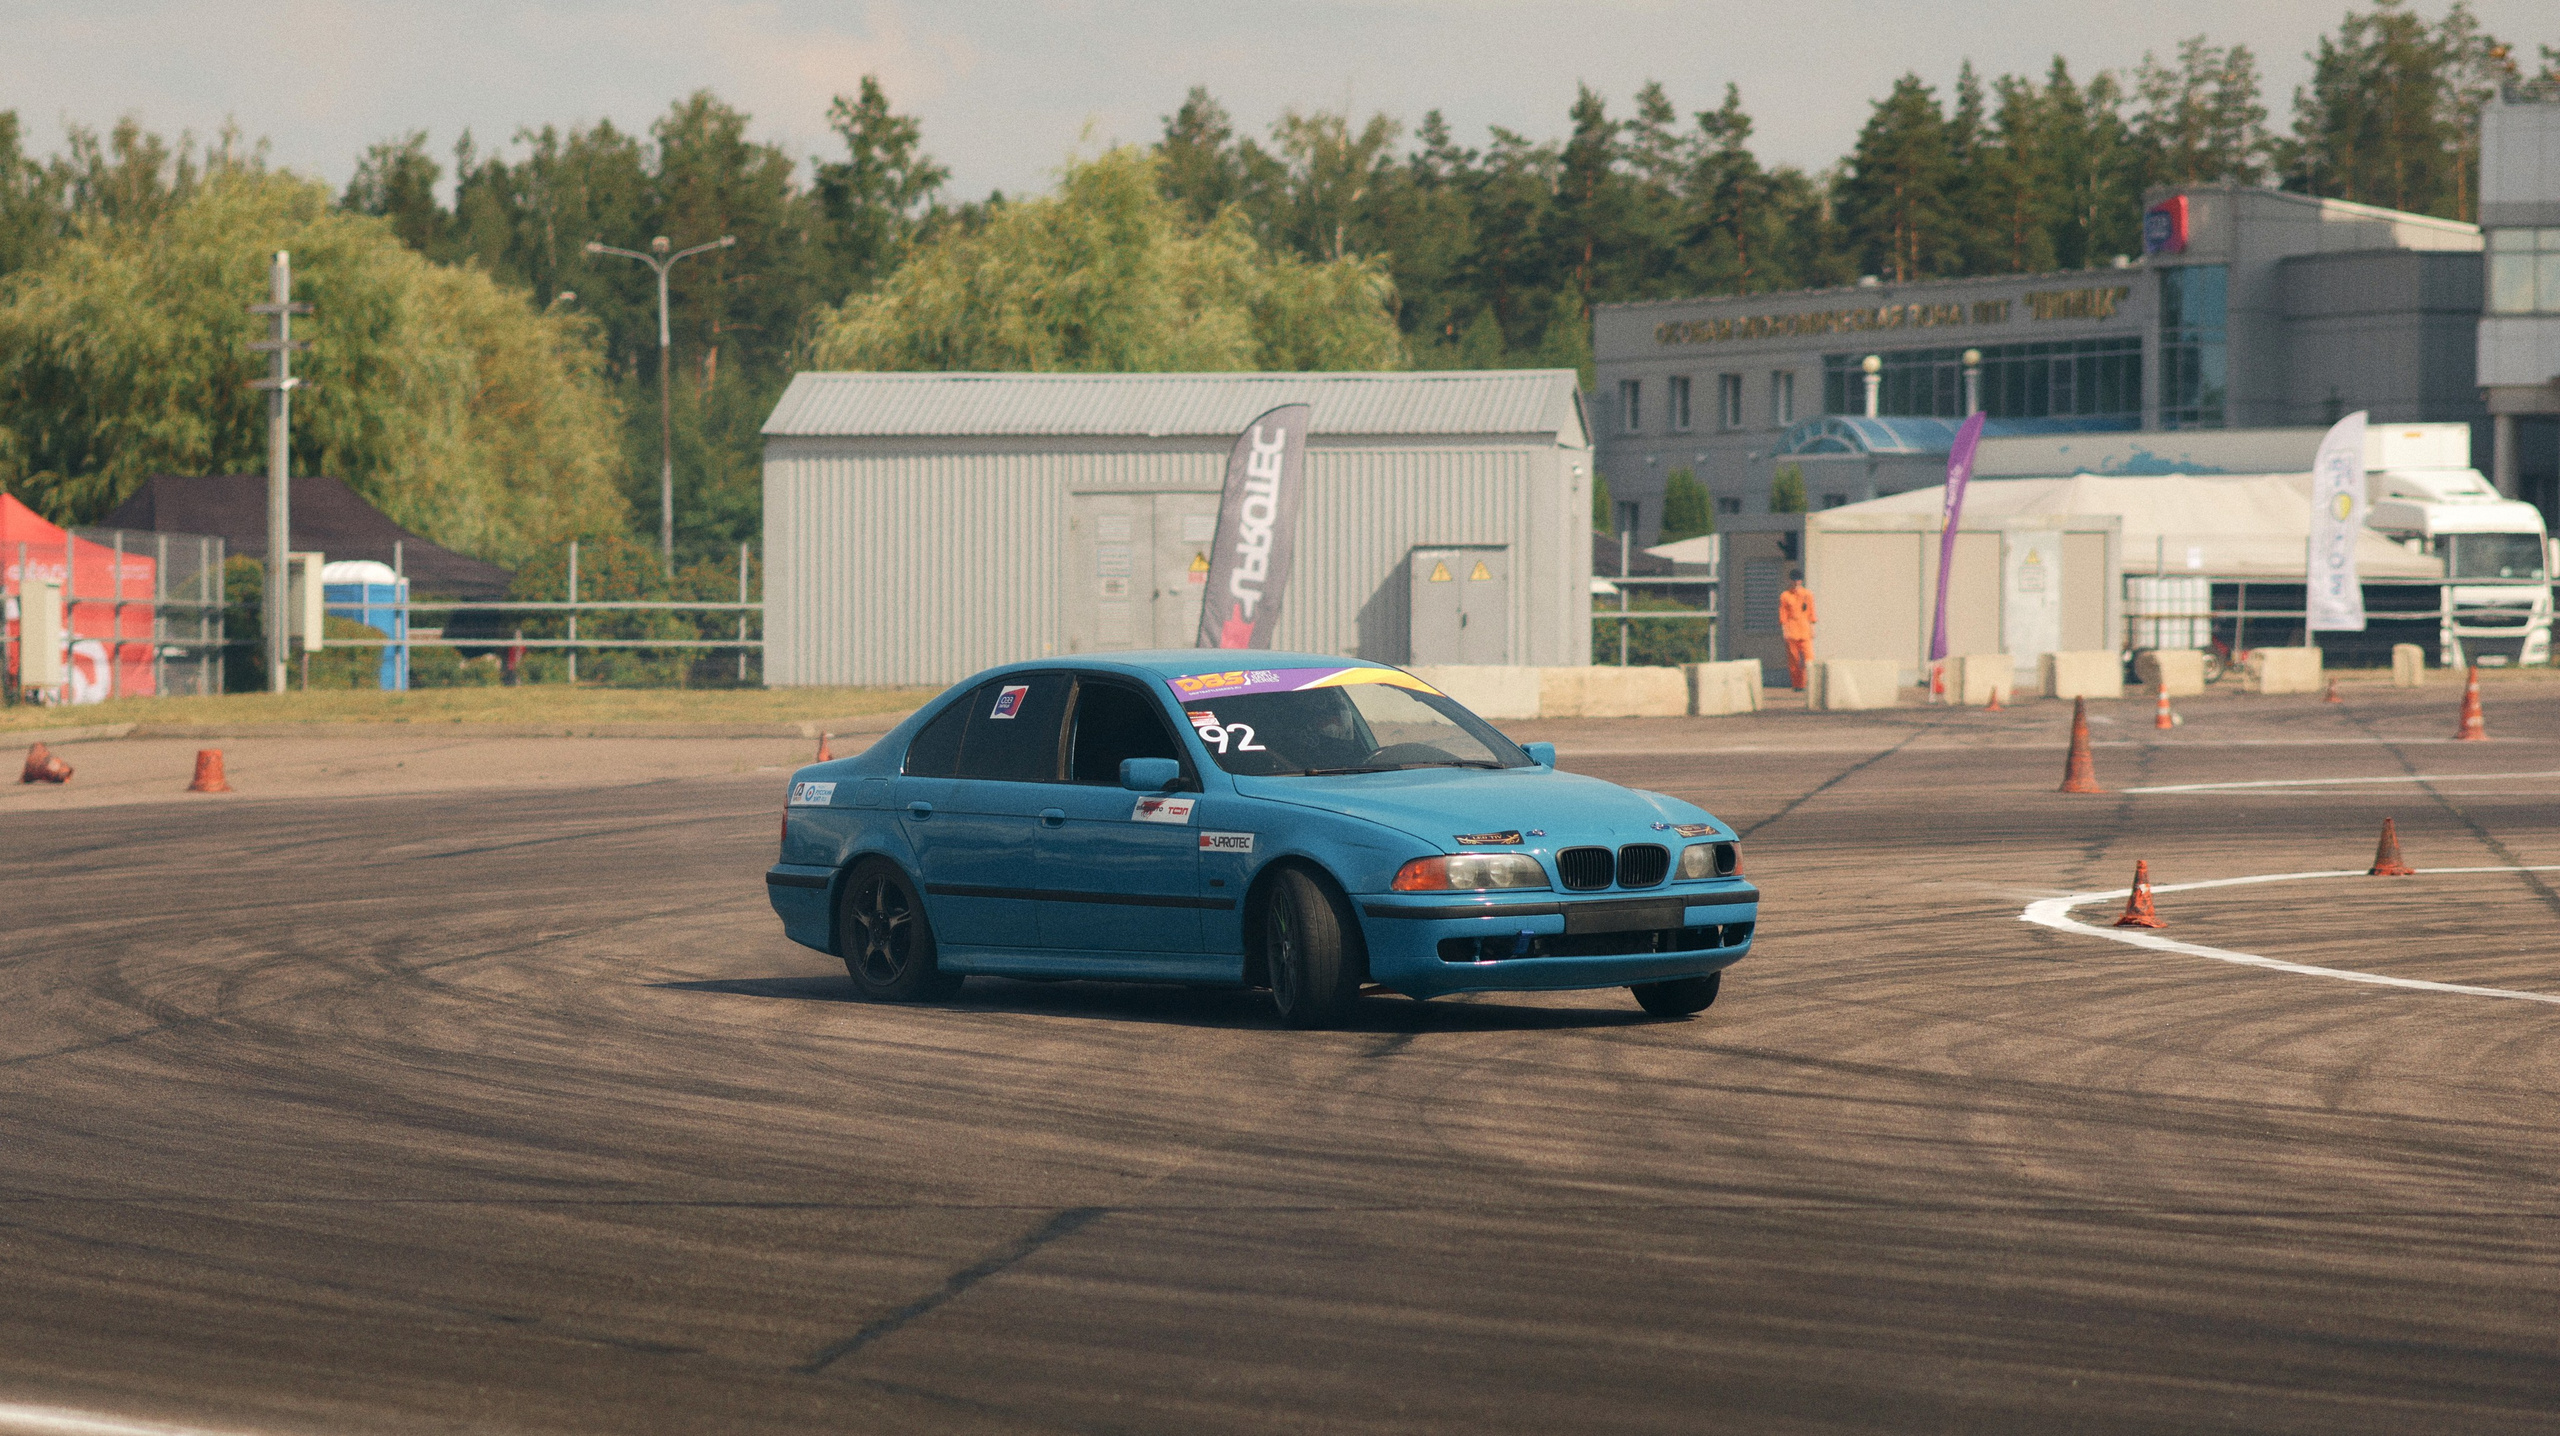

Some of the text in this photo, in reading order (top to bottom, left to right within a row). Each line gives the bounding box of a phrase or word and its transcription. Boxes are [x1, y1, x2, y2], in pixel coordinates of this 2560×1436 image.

[1908, 302, 1962, 328] ЗОНА
[1175, 671, 1246, 691] DBS
[1198, 723, 1266, 754] 92
